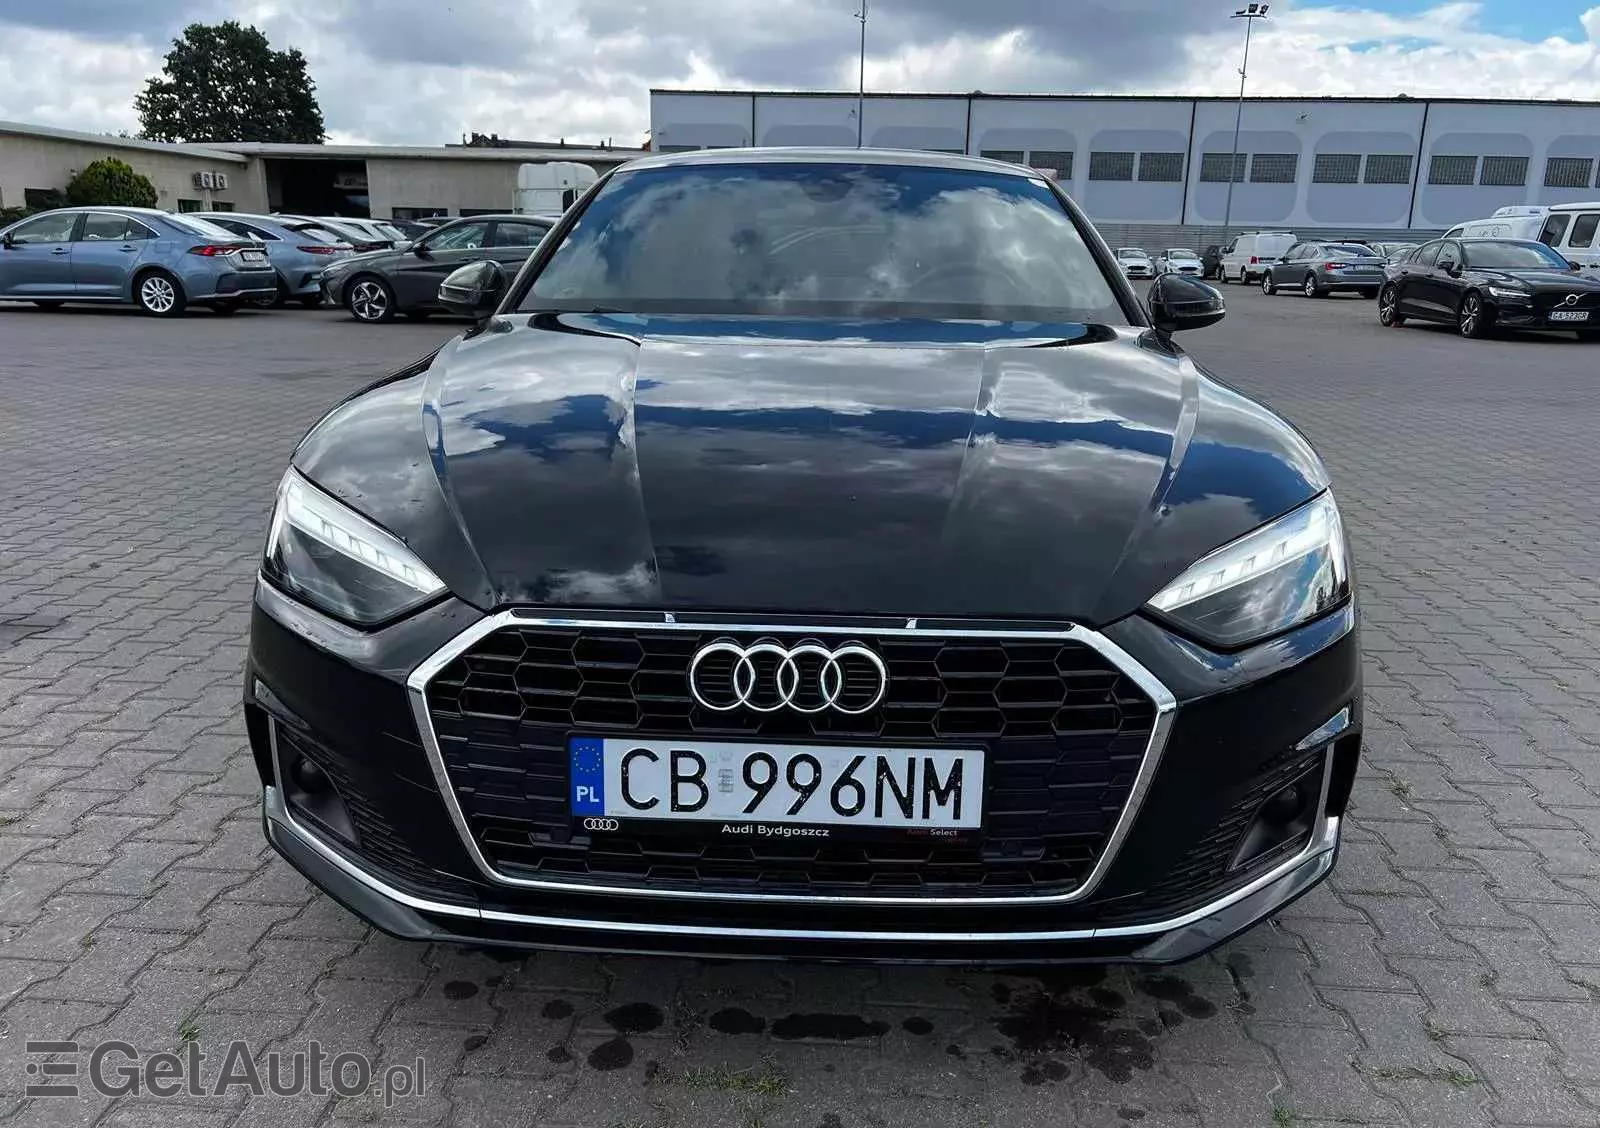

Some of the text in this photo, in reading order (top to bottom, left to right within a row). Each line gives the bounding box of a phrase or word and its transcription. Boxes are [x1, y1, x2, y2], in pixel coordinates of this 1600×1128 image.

[620, 748, 963, 820] CB 996NM
[576, 785, 600, 803] PL
[721, 824, 830, 837] Audi Bydgoszcz
